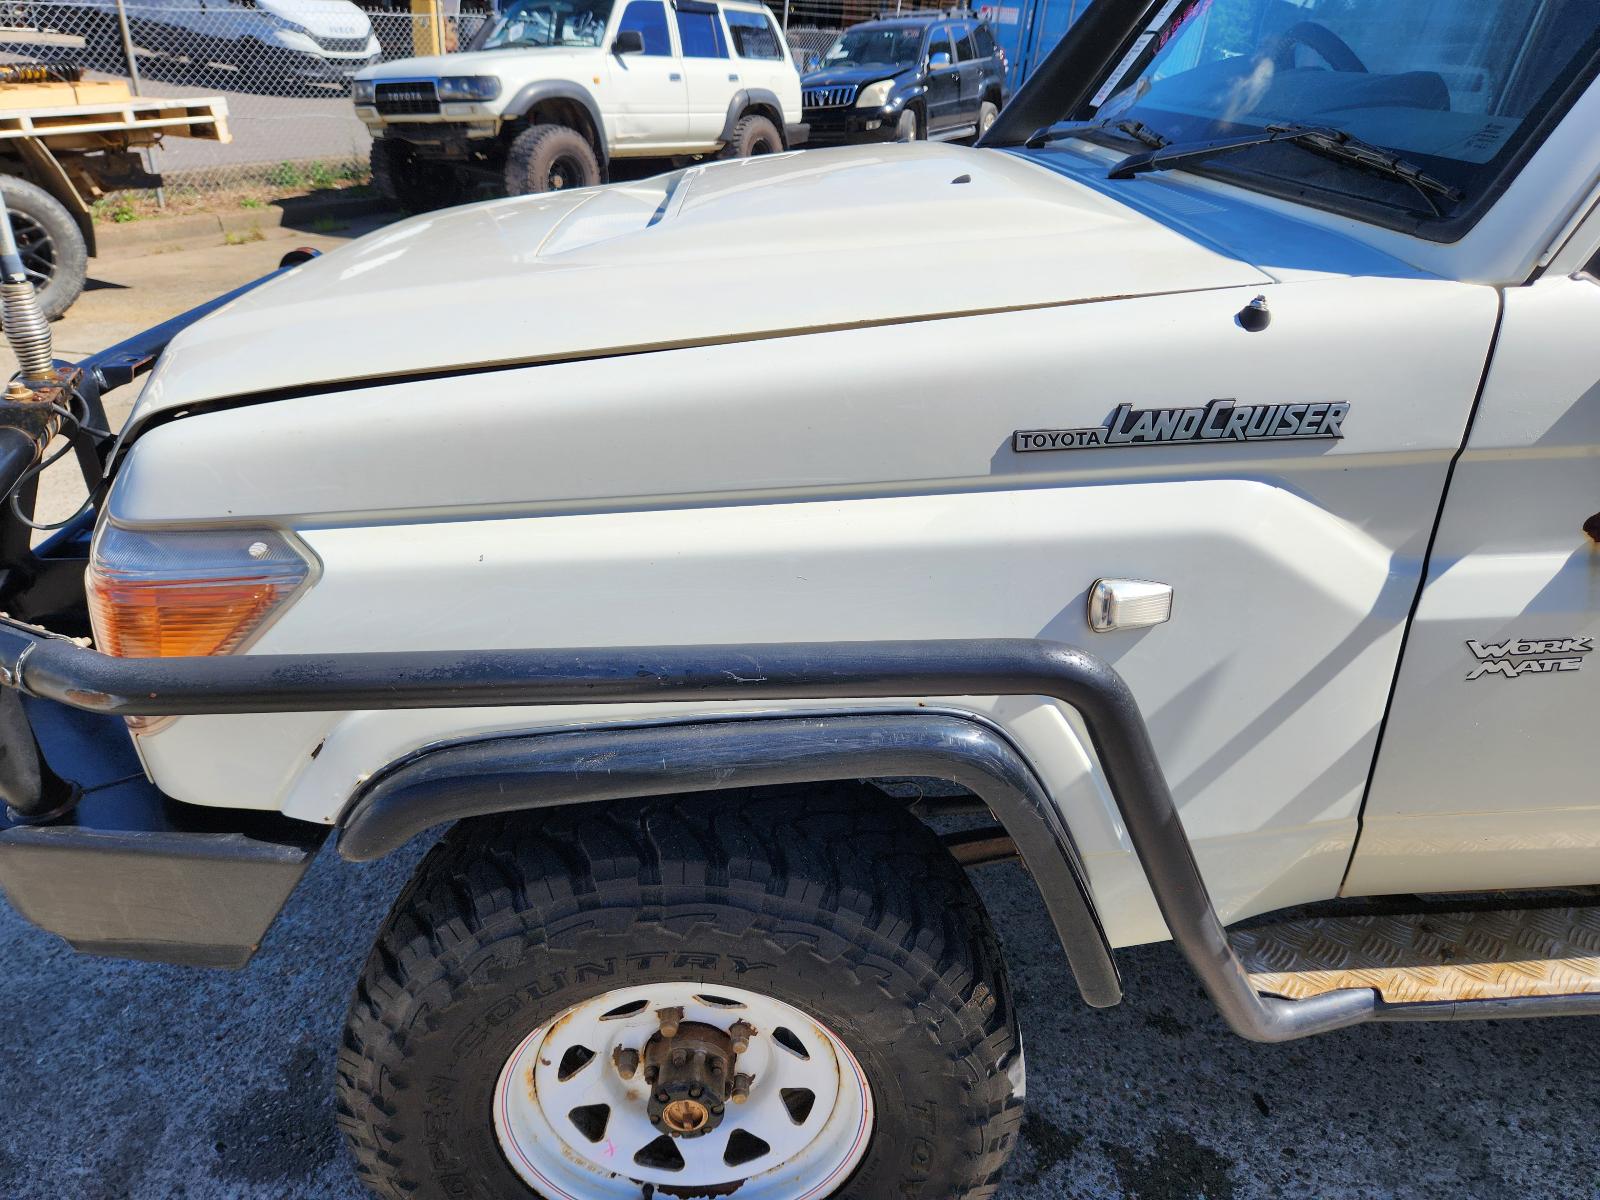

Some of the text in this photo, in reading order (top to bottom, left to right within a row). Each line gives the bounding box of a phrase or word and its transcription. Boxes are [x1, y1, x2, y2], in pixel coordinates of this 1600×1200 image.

[388, 92, 422, 101] TOYOTA
[1020, 432, 1100, 449] TOYOTA
[1465, 638, 1593, 659] WORK
[1465, 657, 1582, 681] MATE
[449, 951, 779, 1064] COUNTRY
